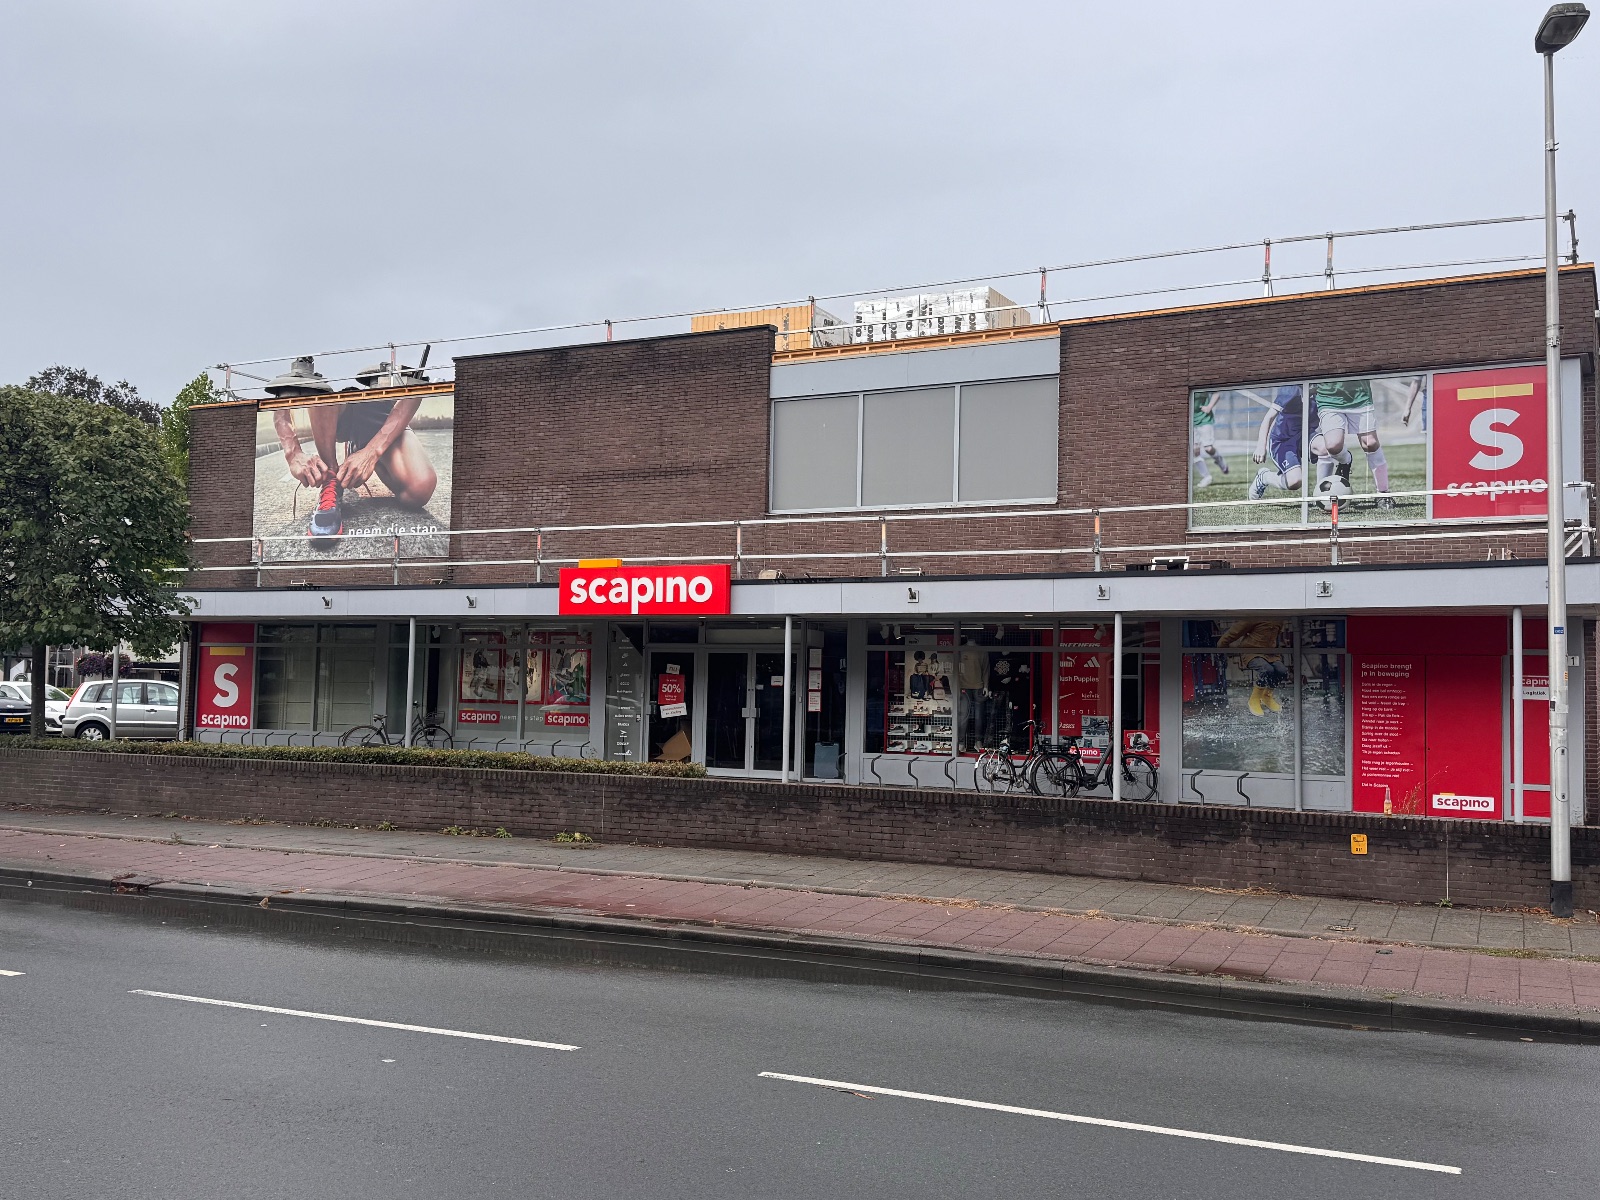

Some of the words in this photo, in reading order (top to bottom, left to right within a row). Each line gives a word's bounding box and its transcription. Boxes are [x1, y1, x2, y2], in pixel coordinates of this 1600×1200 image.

[1469, 408, 1523, 470] S
[348, 527, 382, 537] neem
[386, 523, 406, 536] die
[410, 524, 438, 538] stap
[570, 576, 713, 615] scapino
[1390, 663, 1412, 671] brengt
[1570, 656, 1576, 666] 1
[1073, 675, 1100, 683] Puppies
[1361, 670, 1368, 678] je
[212, 663, 239, 708] S
[661, 683, 682, 693] 50%
[1522, 678, 1549, 688] capin
[201, 713, 248, 729] scapino
[461, 712, 498, 723] scapino
[547, 714, 586, 727] scapino
[1437, 797, 1490, 810] scapino
